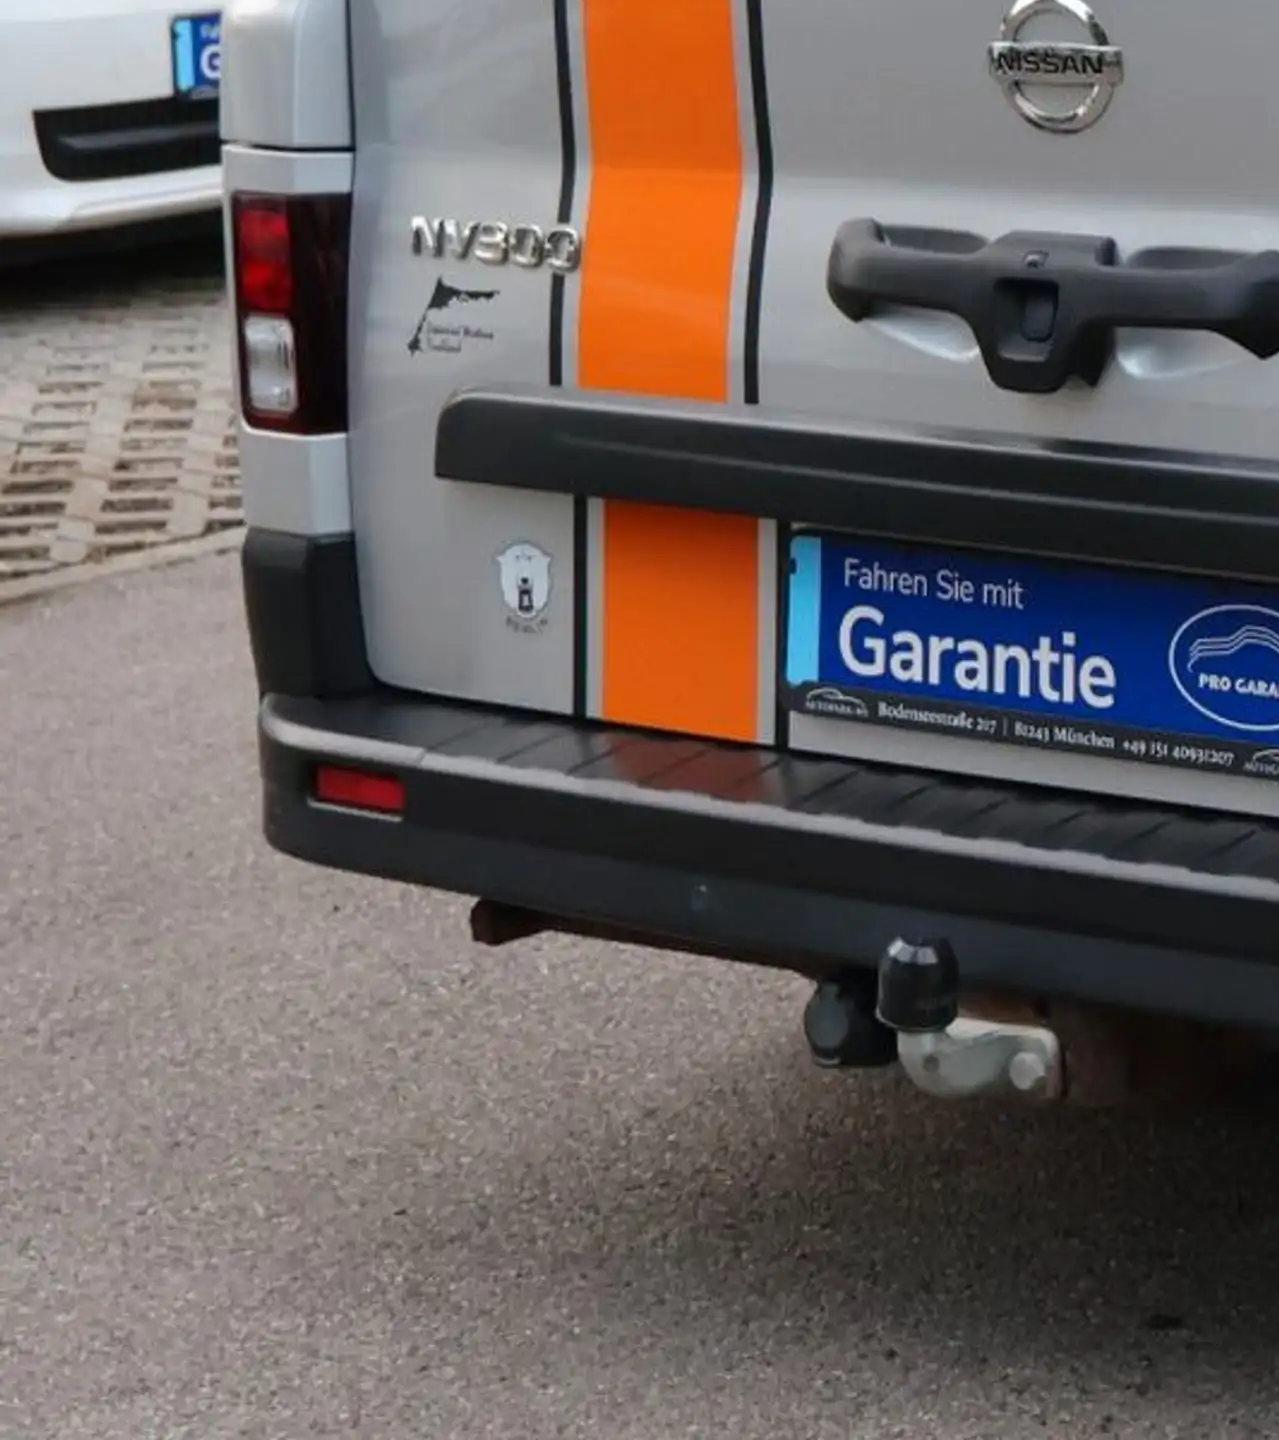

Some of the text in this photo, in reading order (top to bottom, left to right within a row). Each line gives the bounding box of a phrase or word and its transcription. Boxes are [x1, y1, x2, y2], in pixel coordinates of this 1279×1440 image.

[996, 47, 1103, 74] NISSAN
[410, 215, 582, 273] NV300
[843, 558, 1025, 610] Fahren Sie mit
[838, 604, 1117, 709] Garantie
[1198, 672, 1232, 692] PRO
[1053, 726, 1116, 749] München
[1122, 739, 1146, 757] +49
[1150, 740, 1169, 758] 151
